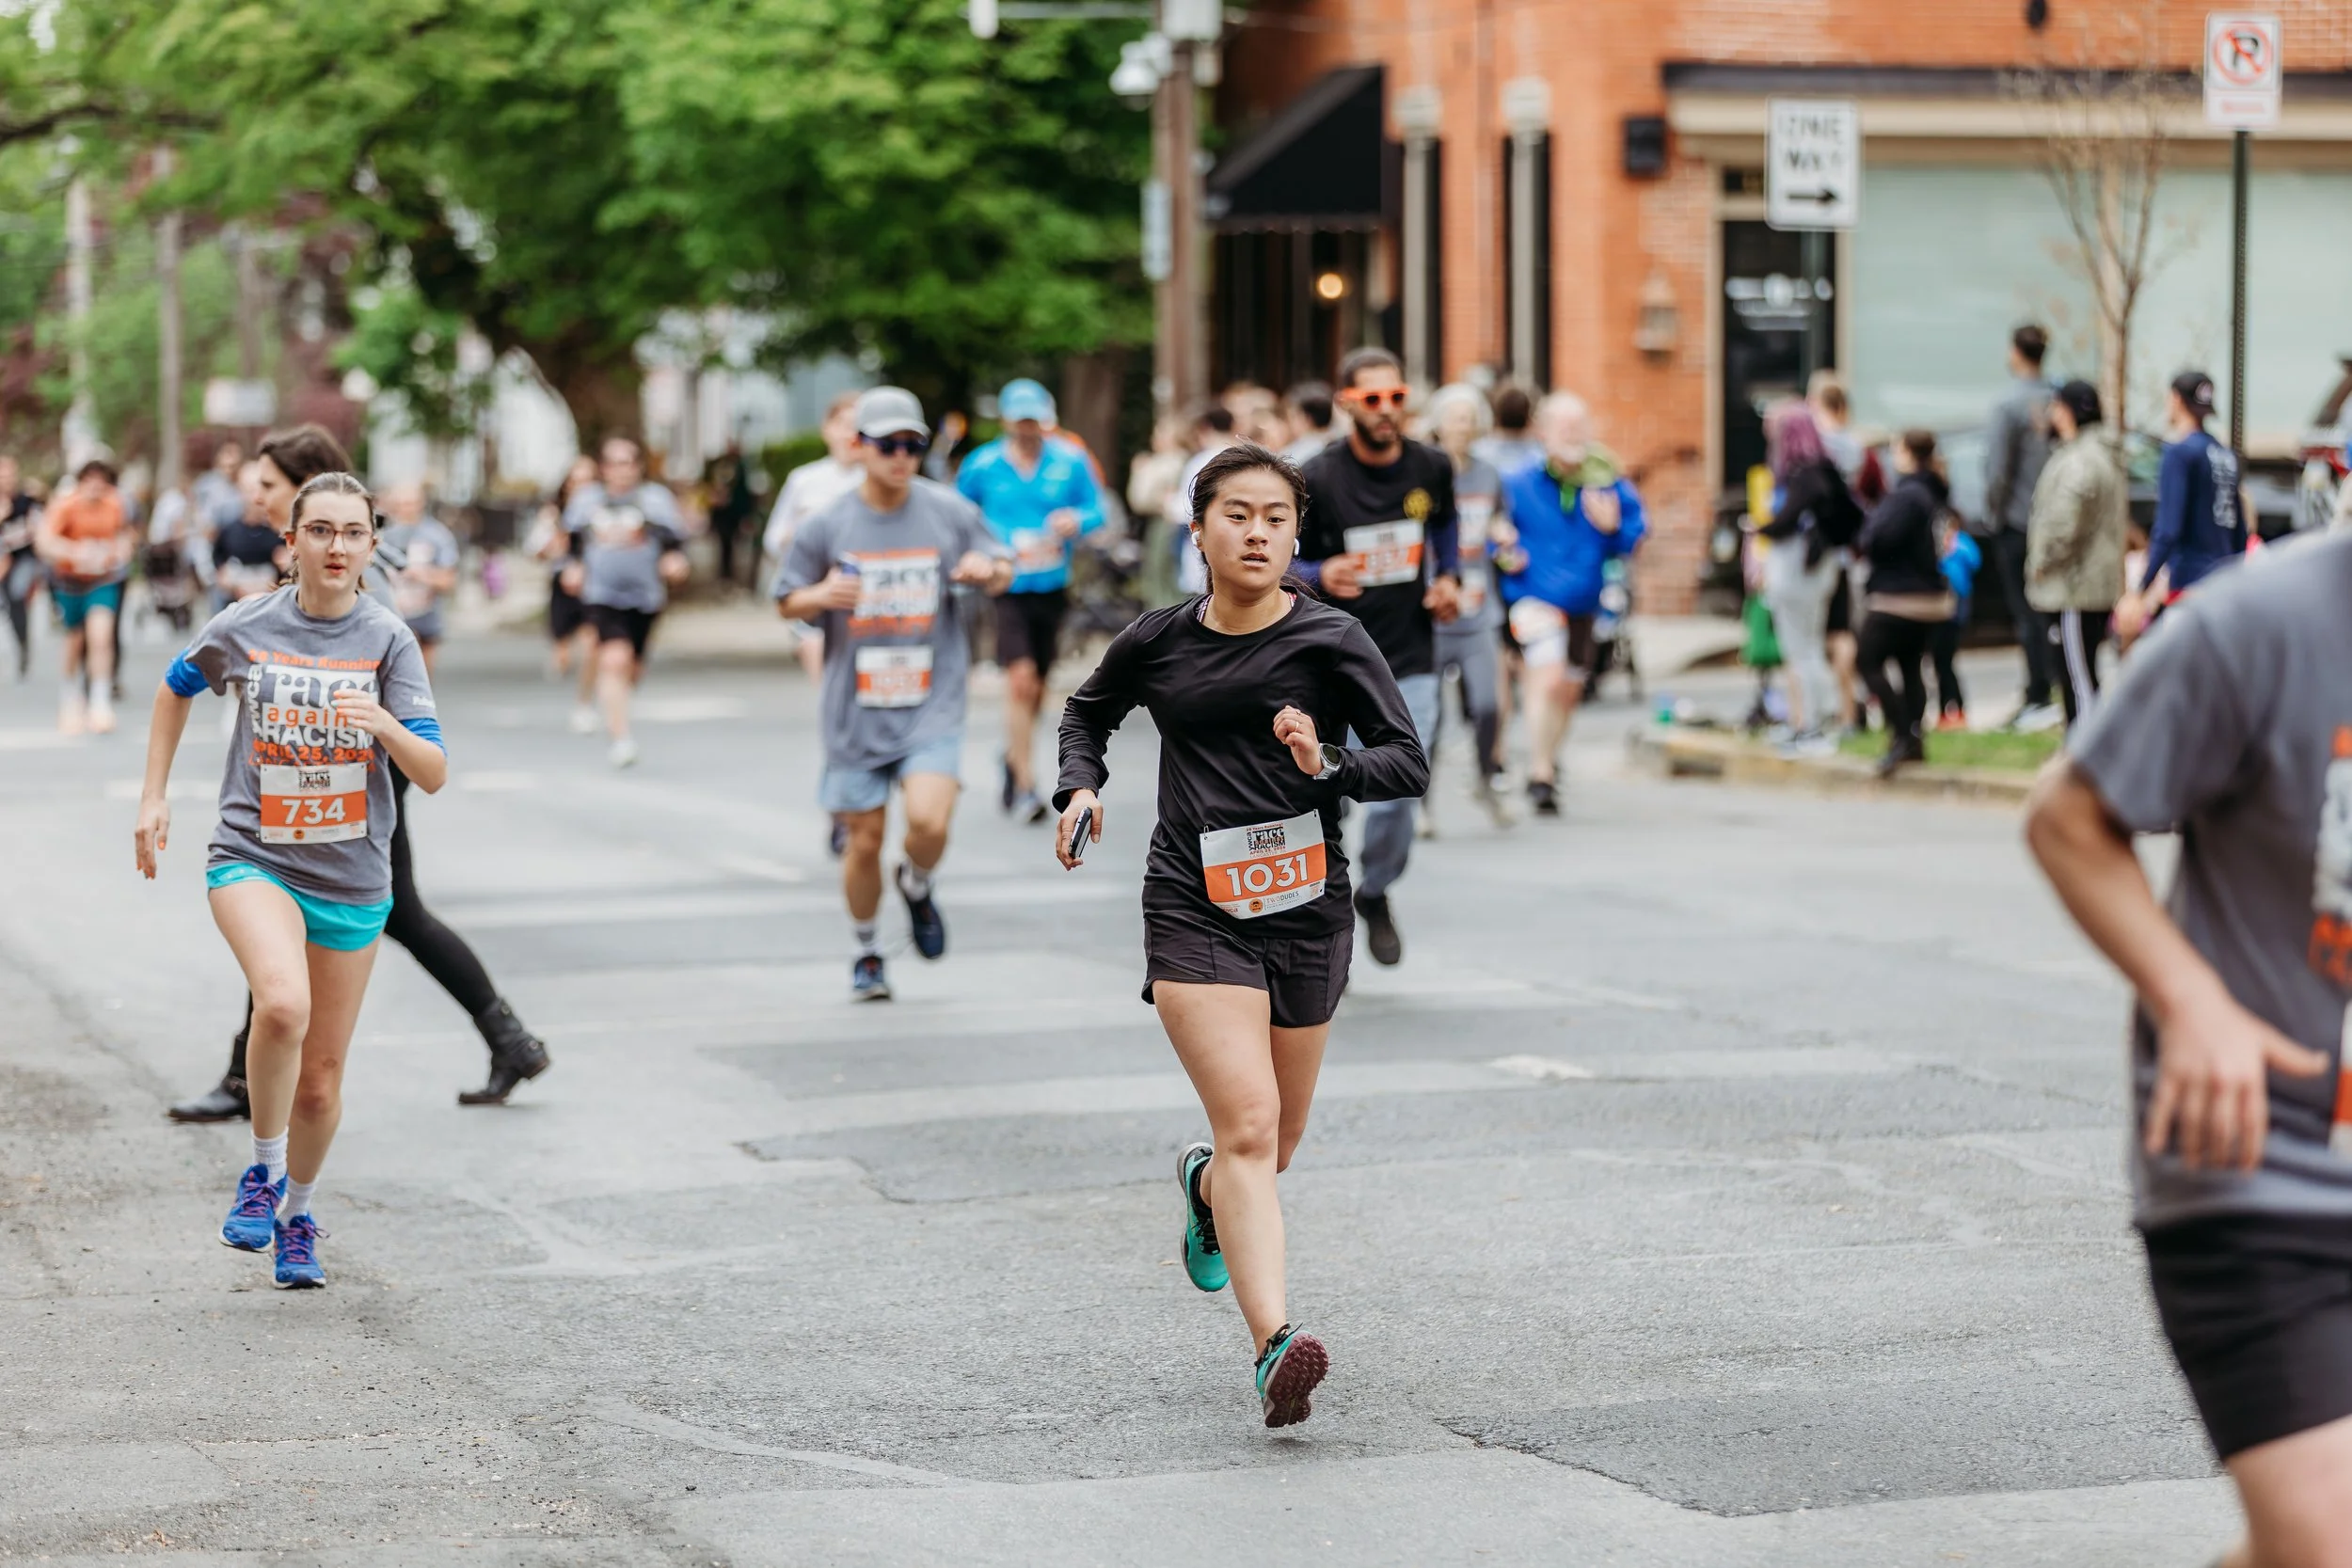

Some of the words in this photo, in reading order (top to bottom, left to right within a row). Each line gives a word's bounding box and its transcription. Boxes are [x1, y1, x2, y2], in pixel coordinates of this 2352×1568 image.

[273, 650, 314, 667] Years
[267, 707, 349, 728] again
[262, 723, 374, 750] RACISM
[281, 797, 346, 825] 734
[1252, 828, 1285, 841] race
[1254, 839, 1286, 850] RACISM
[1226, 853, 1309, 896] 1031
